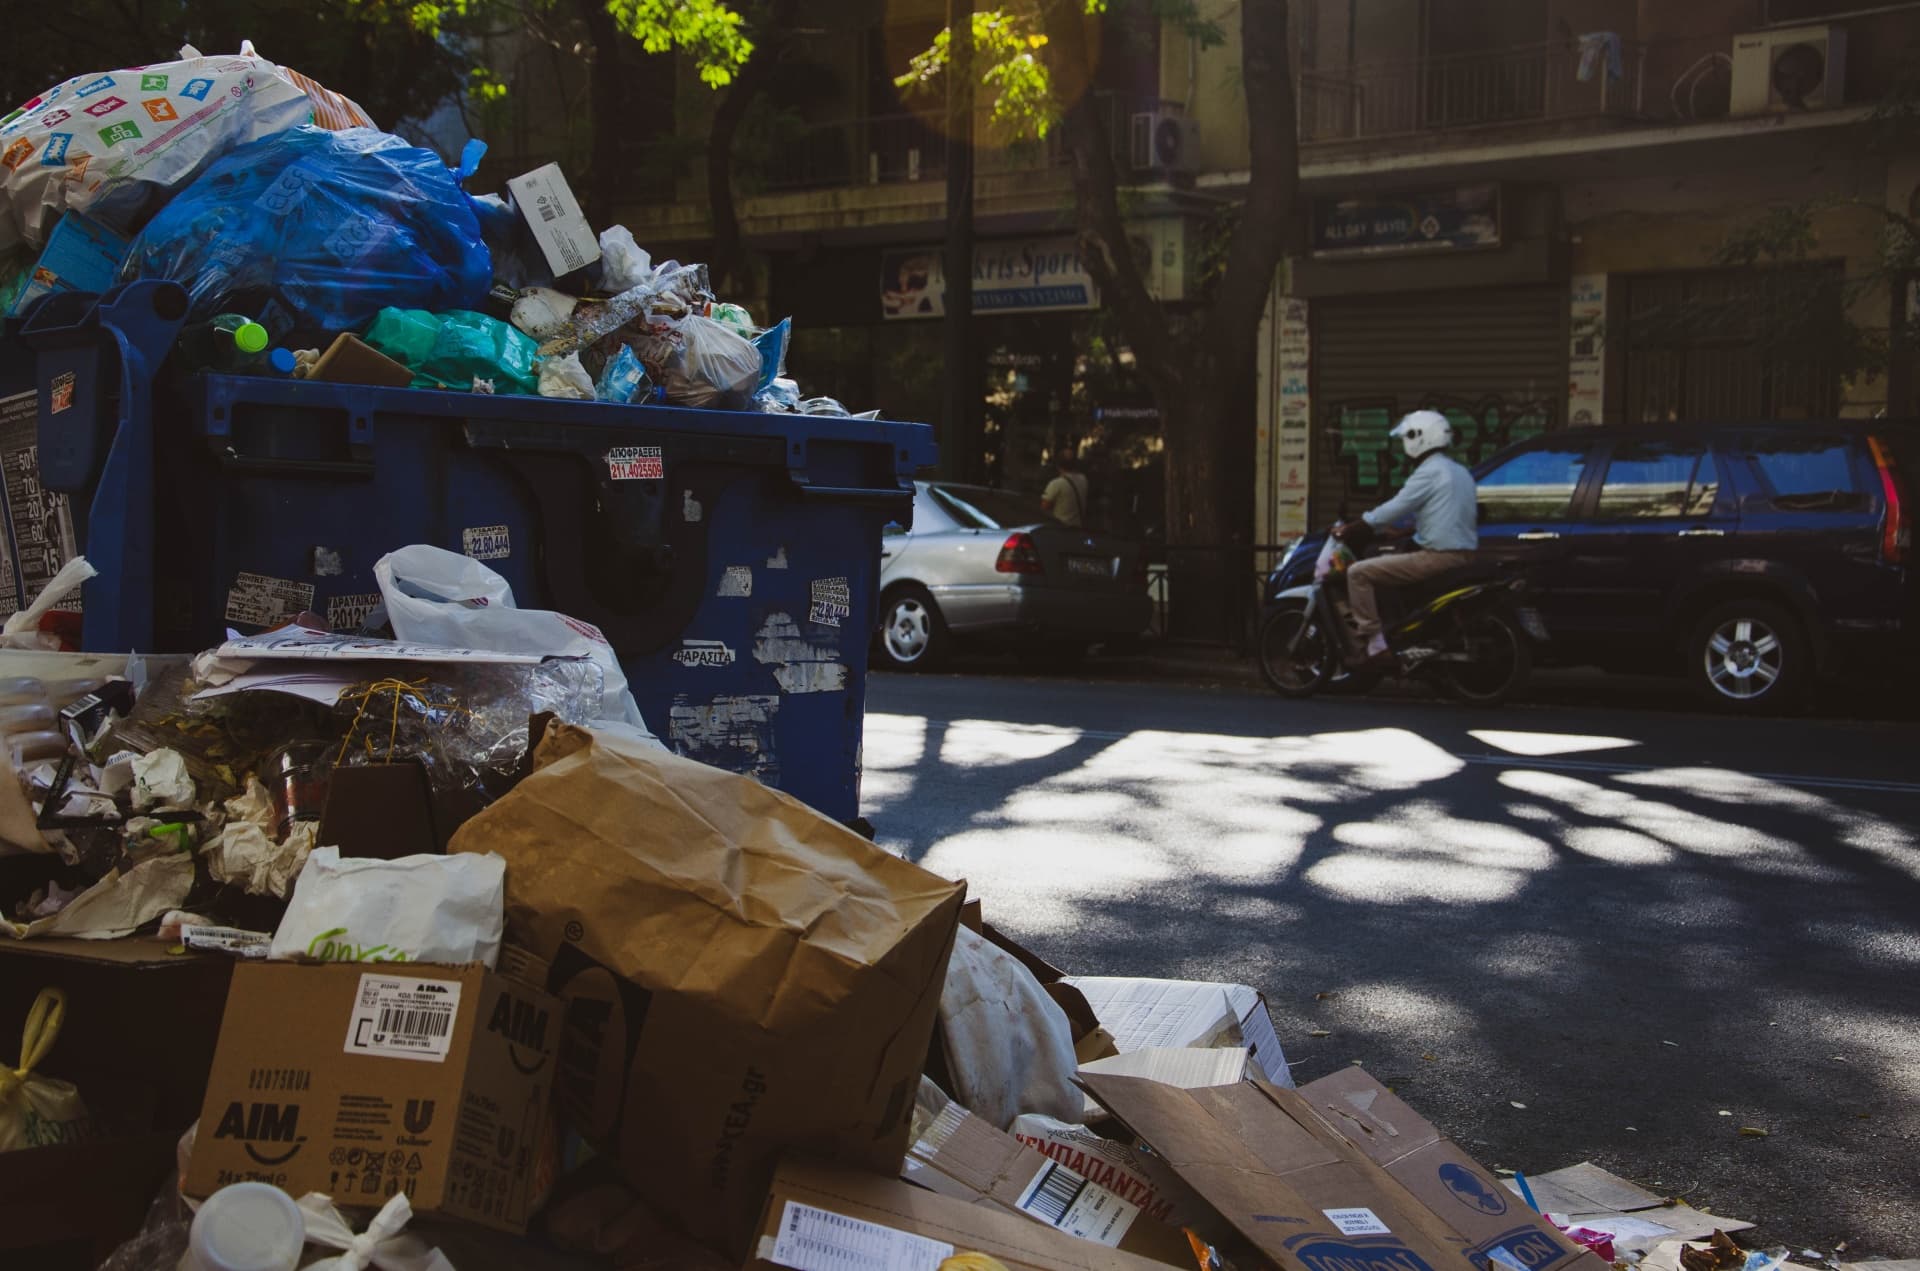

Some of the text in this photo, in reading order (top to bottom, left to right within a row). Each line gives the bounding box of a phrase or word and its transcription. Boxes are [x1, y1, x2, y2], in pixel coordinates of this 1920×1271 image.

[610, 447, 661, 459] ΑΠΟΦΡΑΞΕΙΣ
[611, 463, 662, 479] 211.4025509
[488, 991, 549, 1050] AIM
[213, 1102, 300, 1141] AIM
